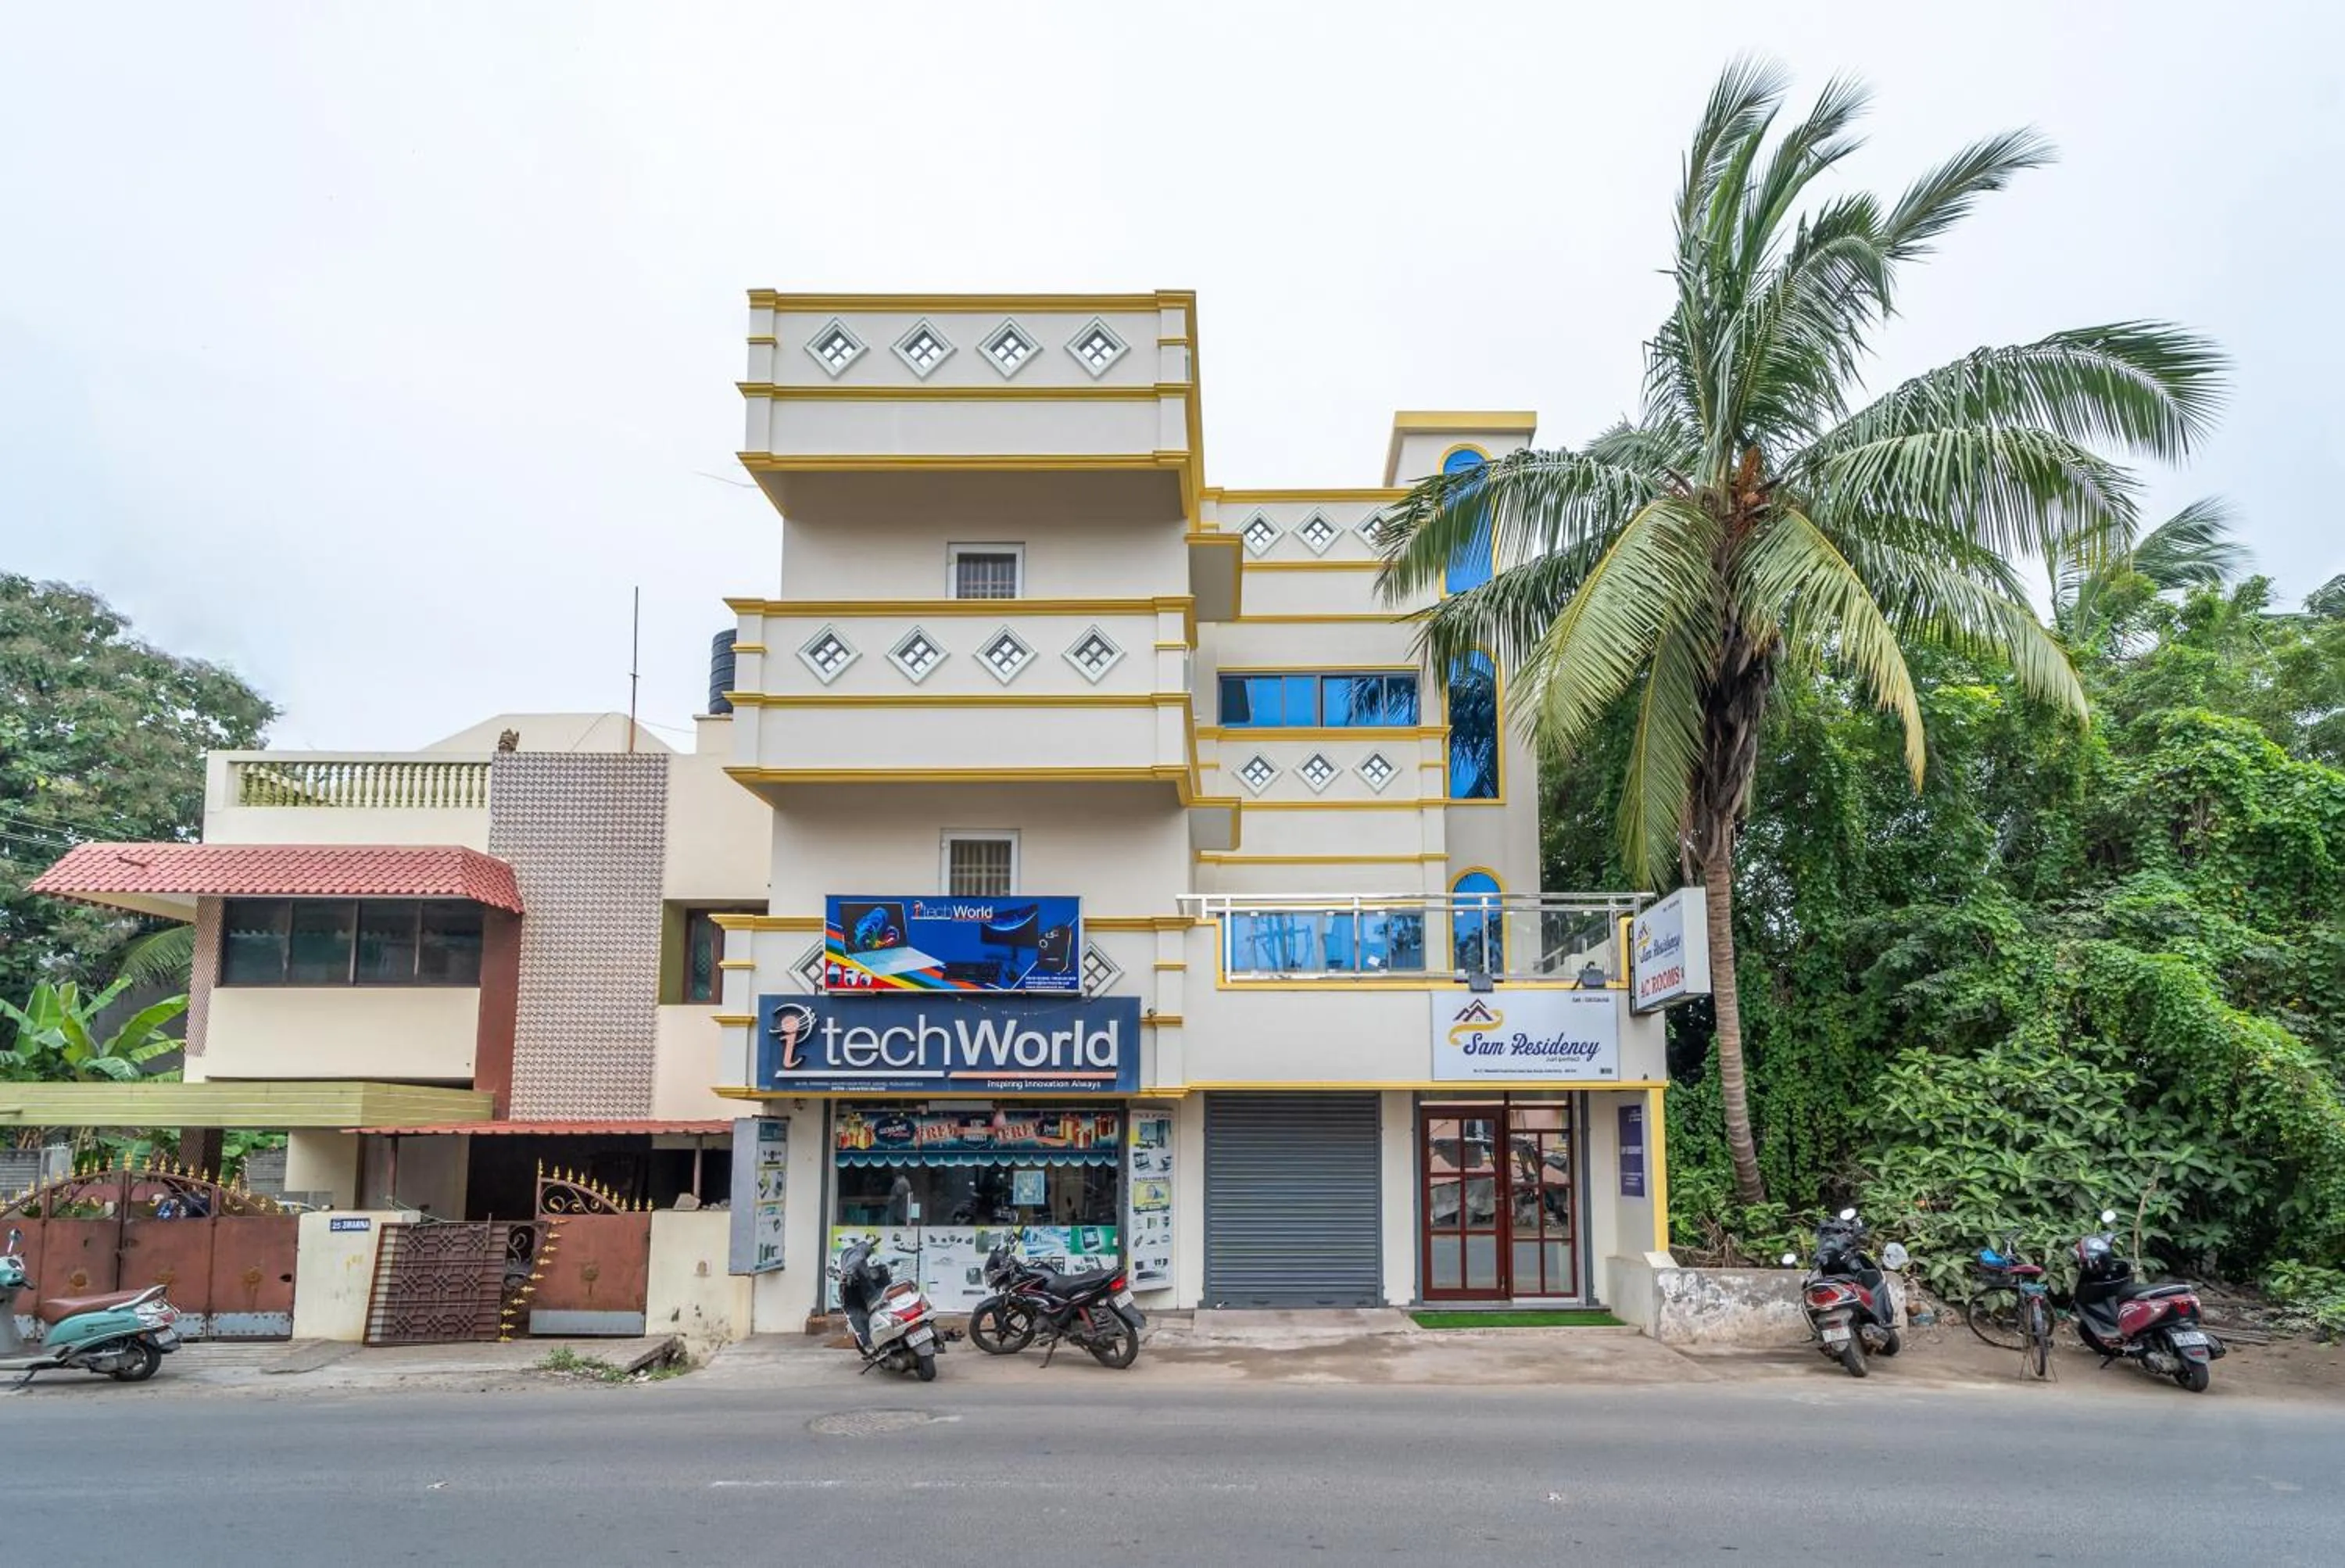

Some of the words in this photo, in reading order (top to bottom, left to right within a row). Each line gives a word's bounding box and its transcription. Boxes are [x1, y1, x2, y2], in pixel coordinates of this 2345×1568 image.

[1641, 978, 1650, 998] AC
[1652, 965, 1680, 993] ROOMS
[1463, 1033, 1505, 1055] Sam
[1510, 1032, 1601, 1062] Residency
[987, 1079, 1023, 1089] Inspiring
[1025, 1079, 1069, 1088] Innovation
[1071, 1080, 1101, 1090] Always
